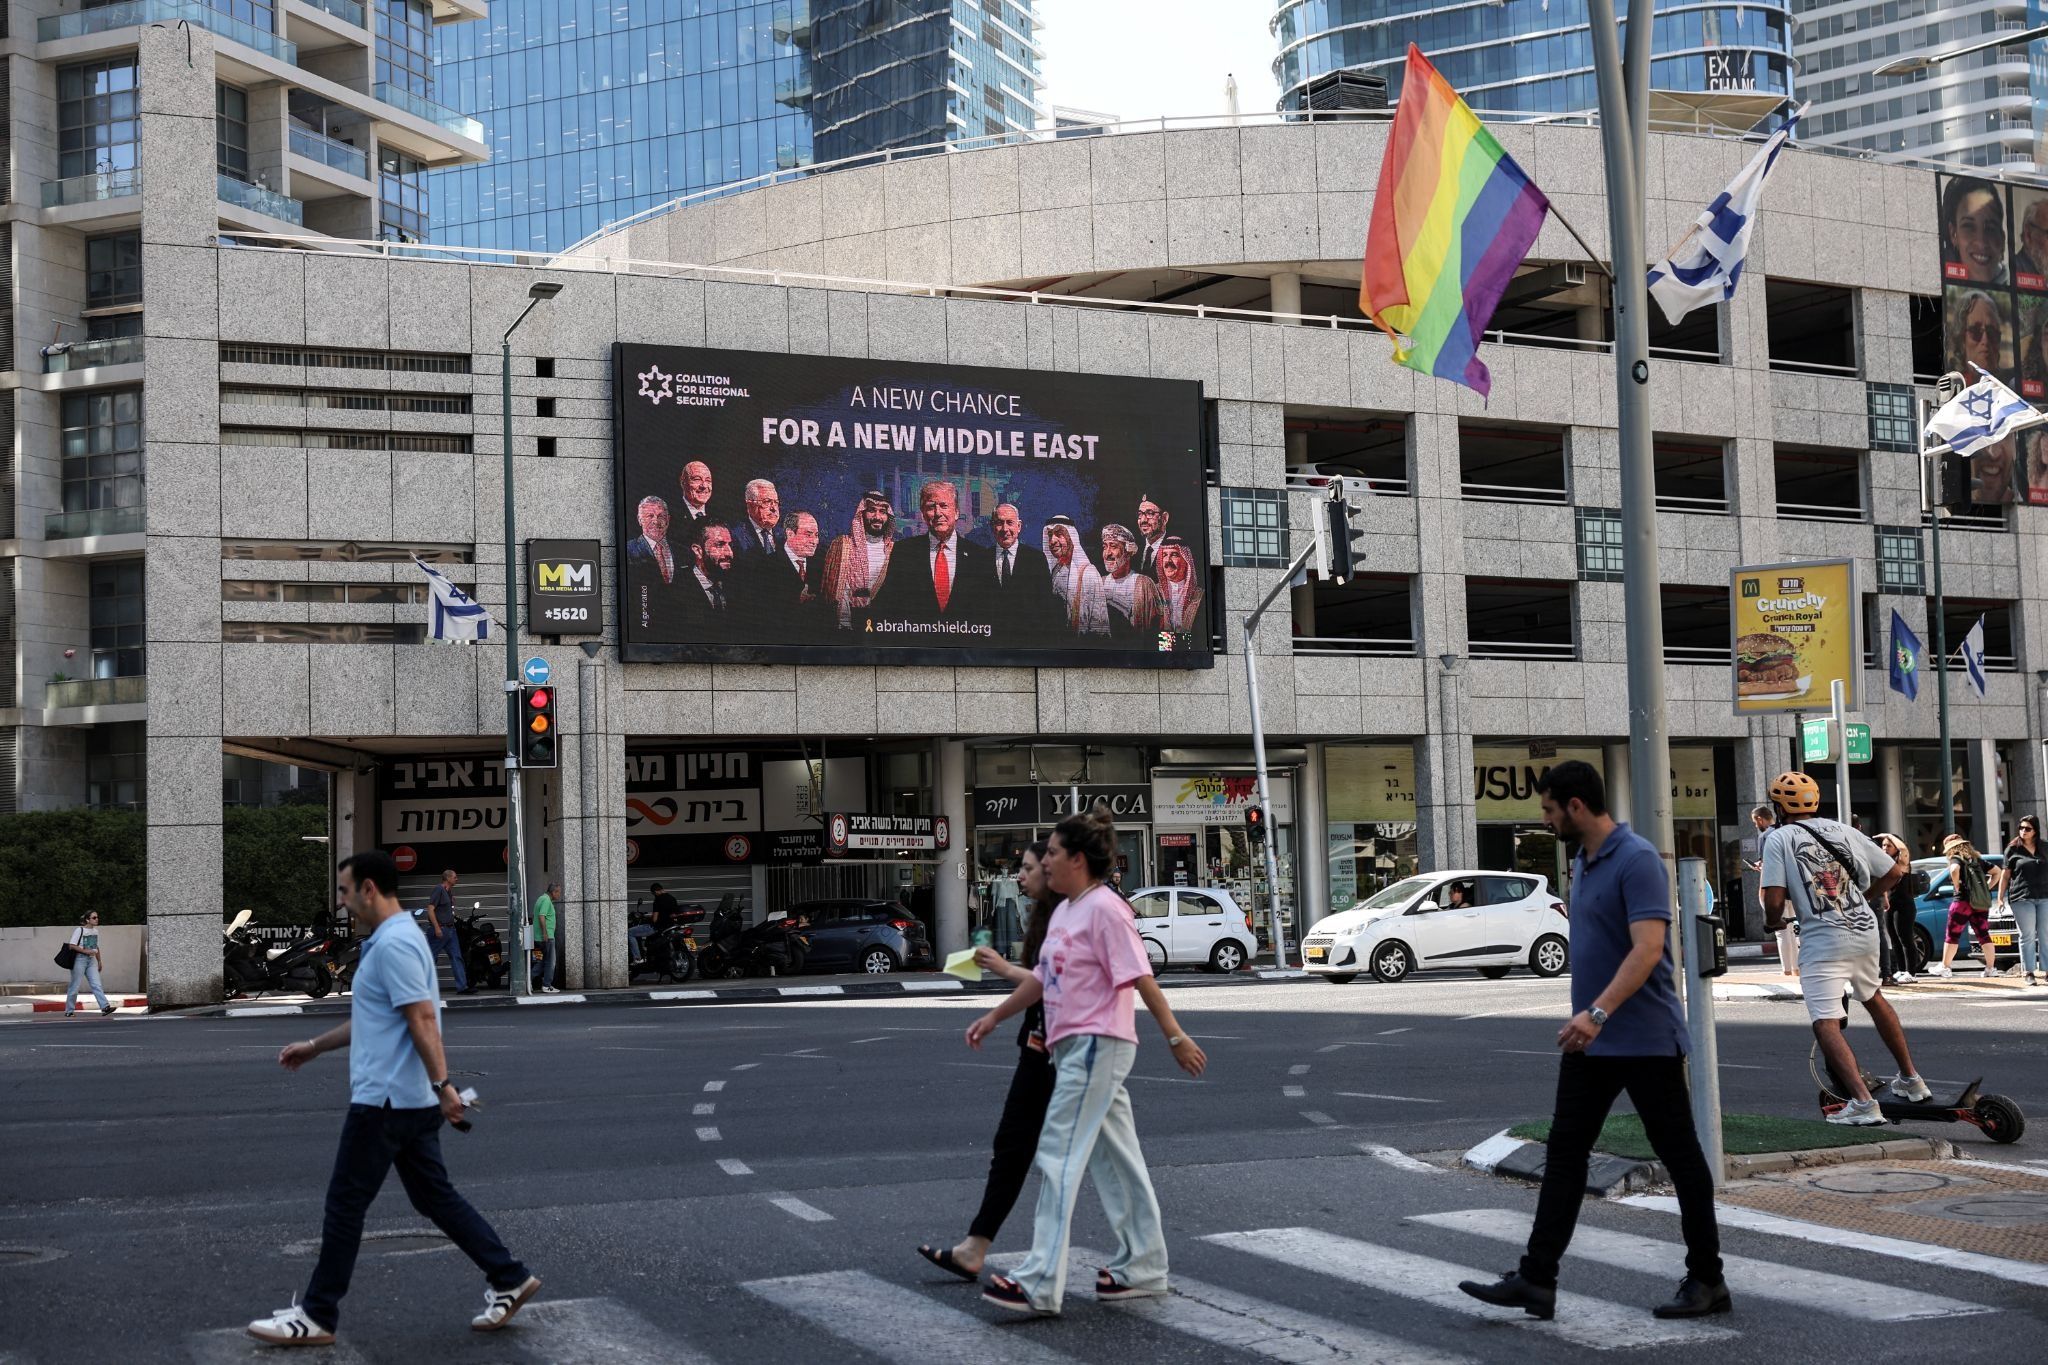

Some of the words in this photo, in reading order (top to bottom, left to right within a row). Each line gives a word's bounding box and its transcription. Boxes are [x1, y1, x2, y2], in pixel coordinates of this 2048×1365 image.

[675, 373, 730, 386] COALITION
[676, 385, 697, 395] FOR
[699, 386, 750, 397] REGIONAL
[676, 395, 725, 407] SECURITY
[850, 386, 866, 408] A
[873, 387, 924, 411] NEW
[930, 390, 1021, 417] CHANCE
[762, 417, 821, 447] FOR
[827, 421, 847, 448] A
[854, 422, 916, 452] NEW
[924, 426, 1025, 457] MIDDLE
[1033, 432, 1099, 461] EAST
[1757, 592, 1827, 612] Crunchy
[1763, 613, 1794, 623] Crunch
[1795, 611, 1822, 621] Royal
[876, 619, 991, 637] abrahamshield.org
[394, 761, 475, 789] אביב
[676, 752, 748, 789] חניון
[1686, 786, 1708, 797] bar
[685, 800, 748, 823] בית
[397, 808, 507, 832] טפחות
[851, 816, 870, 830] אביב
[871, 816, 891, 830] משה
[892, 814, 912, 831] מגדל
[914, 818, 931, 834] חניון
[779, 836, 802, 844] מעבר
[803, 835, 815, 845] אין
[906, 837, 924, 846] כניסת
[773, 847, 793, 856] רגל!
[794, 846, 821, 855] להולכי
[1332, 895, 1349, 904] 8.50
